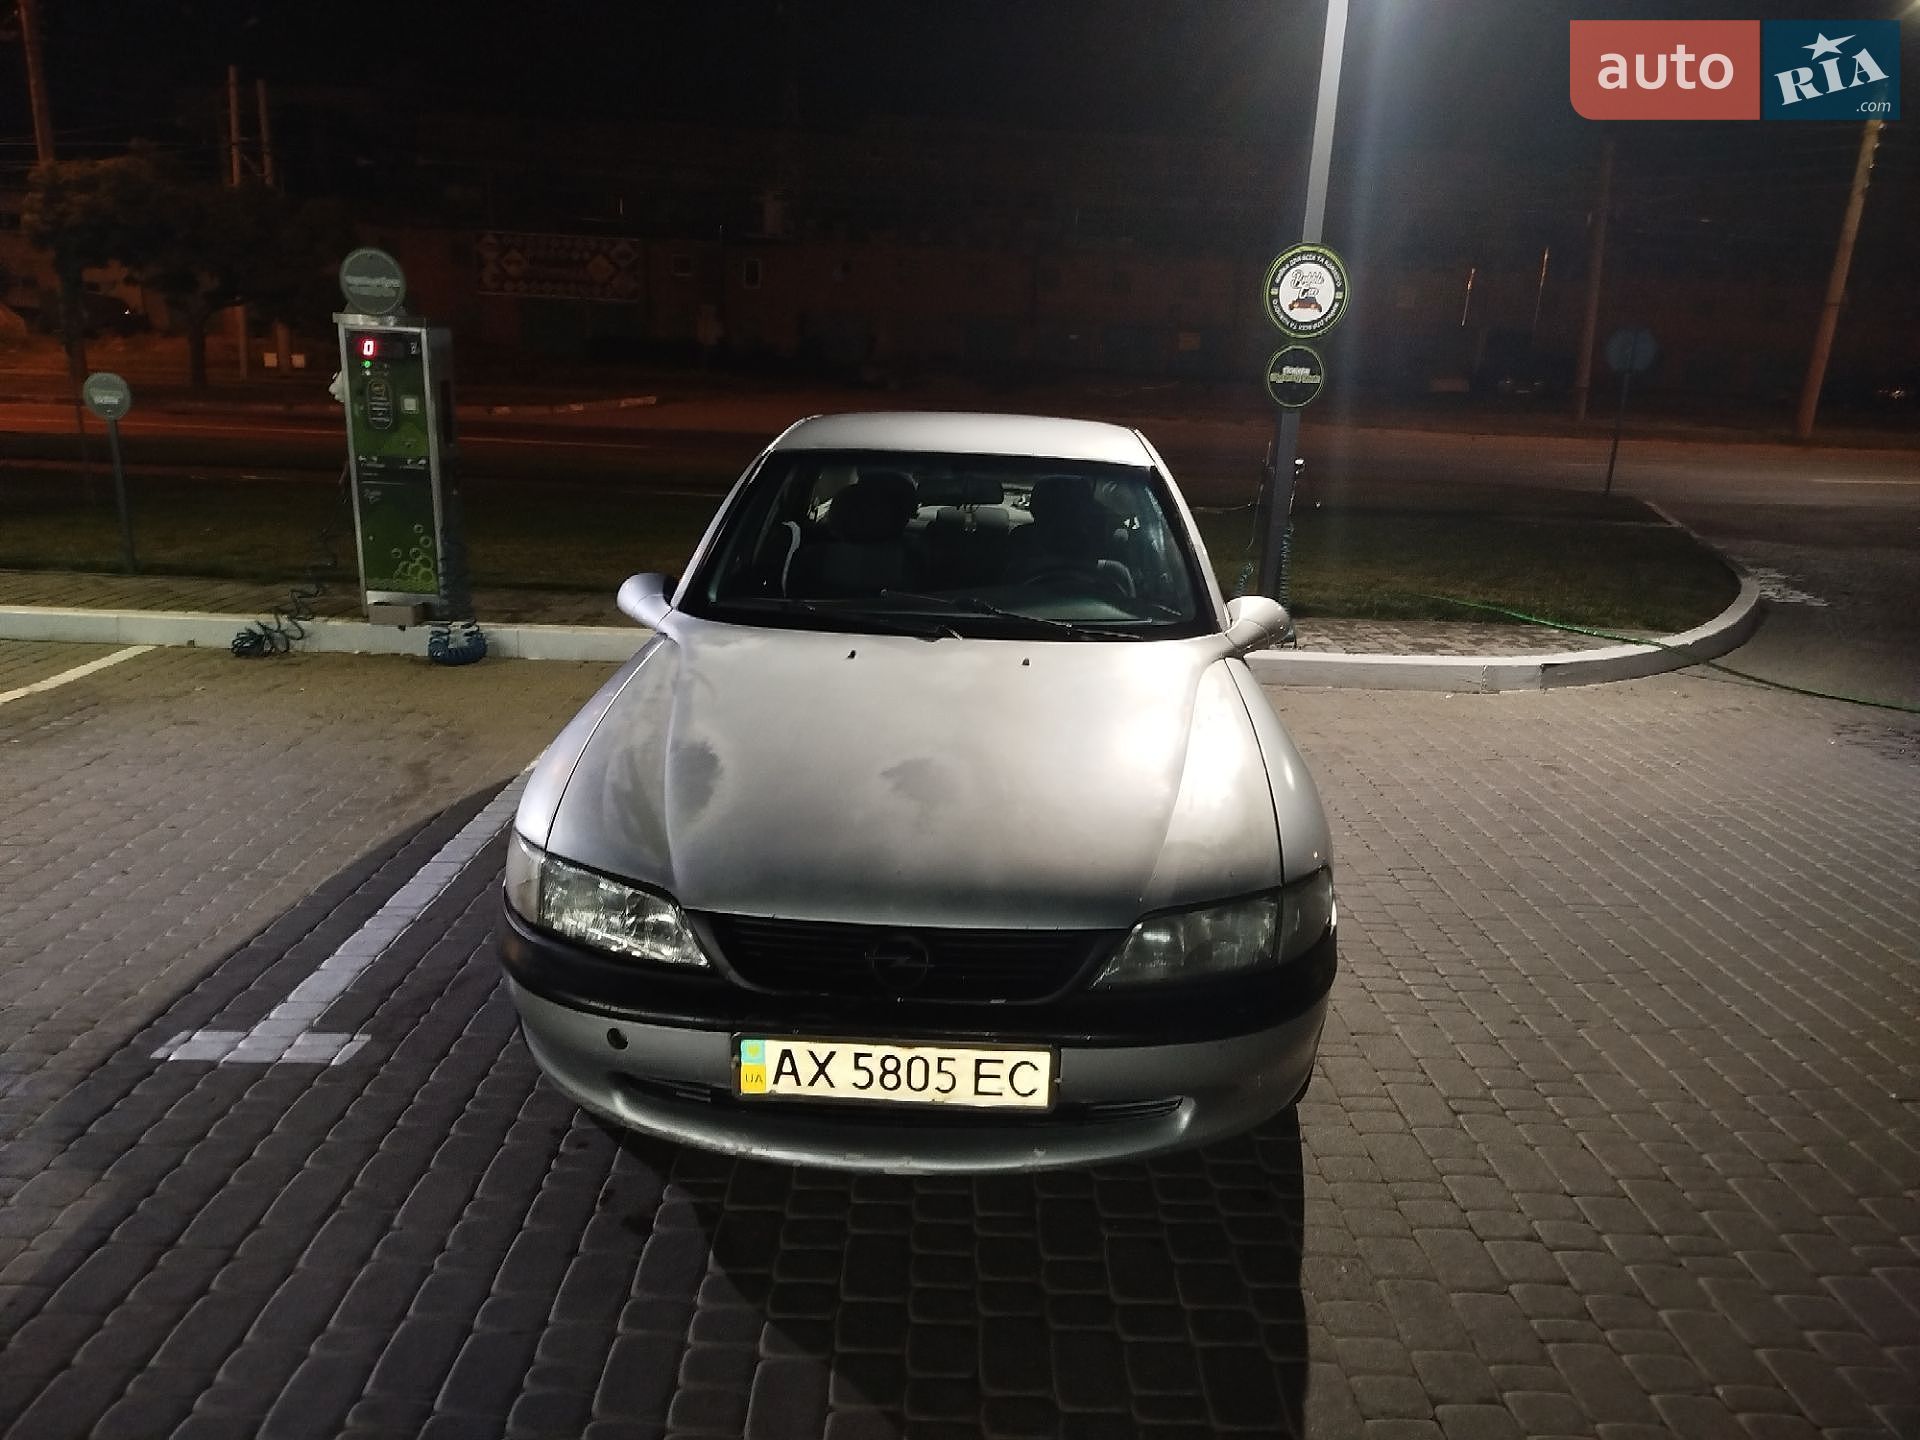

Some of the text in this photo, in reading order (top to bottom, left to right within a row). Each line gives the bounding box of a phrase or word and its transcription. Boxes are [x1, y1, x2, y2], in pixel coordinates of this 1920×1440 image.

[772, 1048, 1040, 1097] AX 5805 EC
